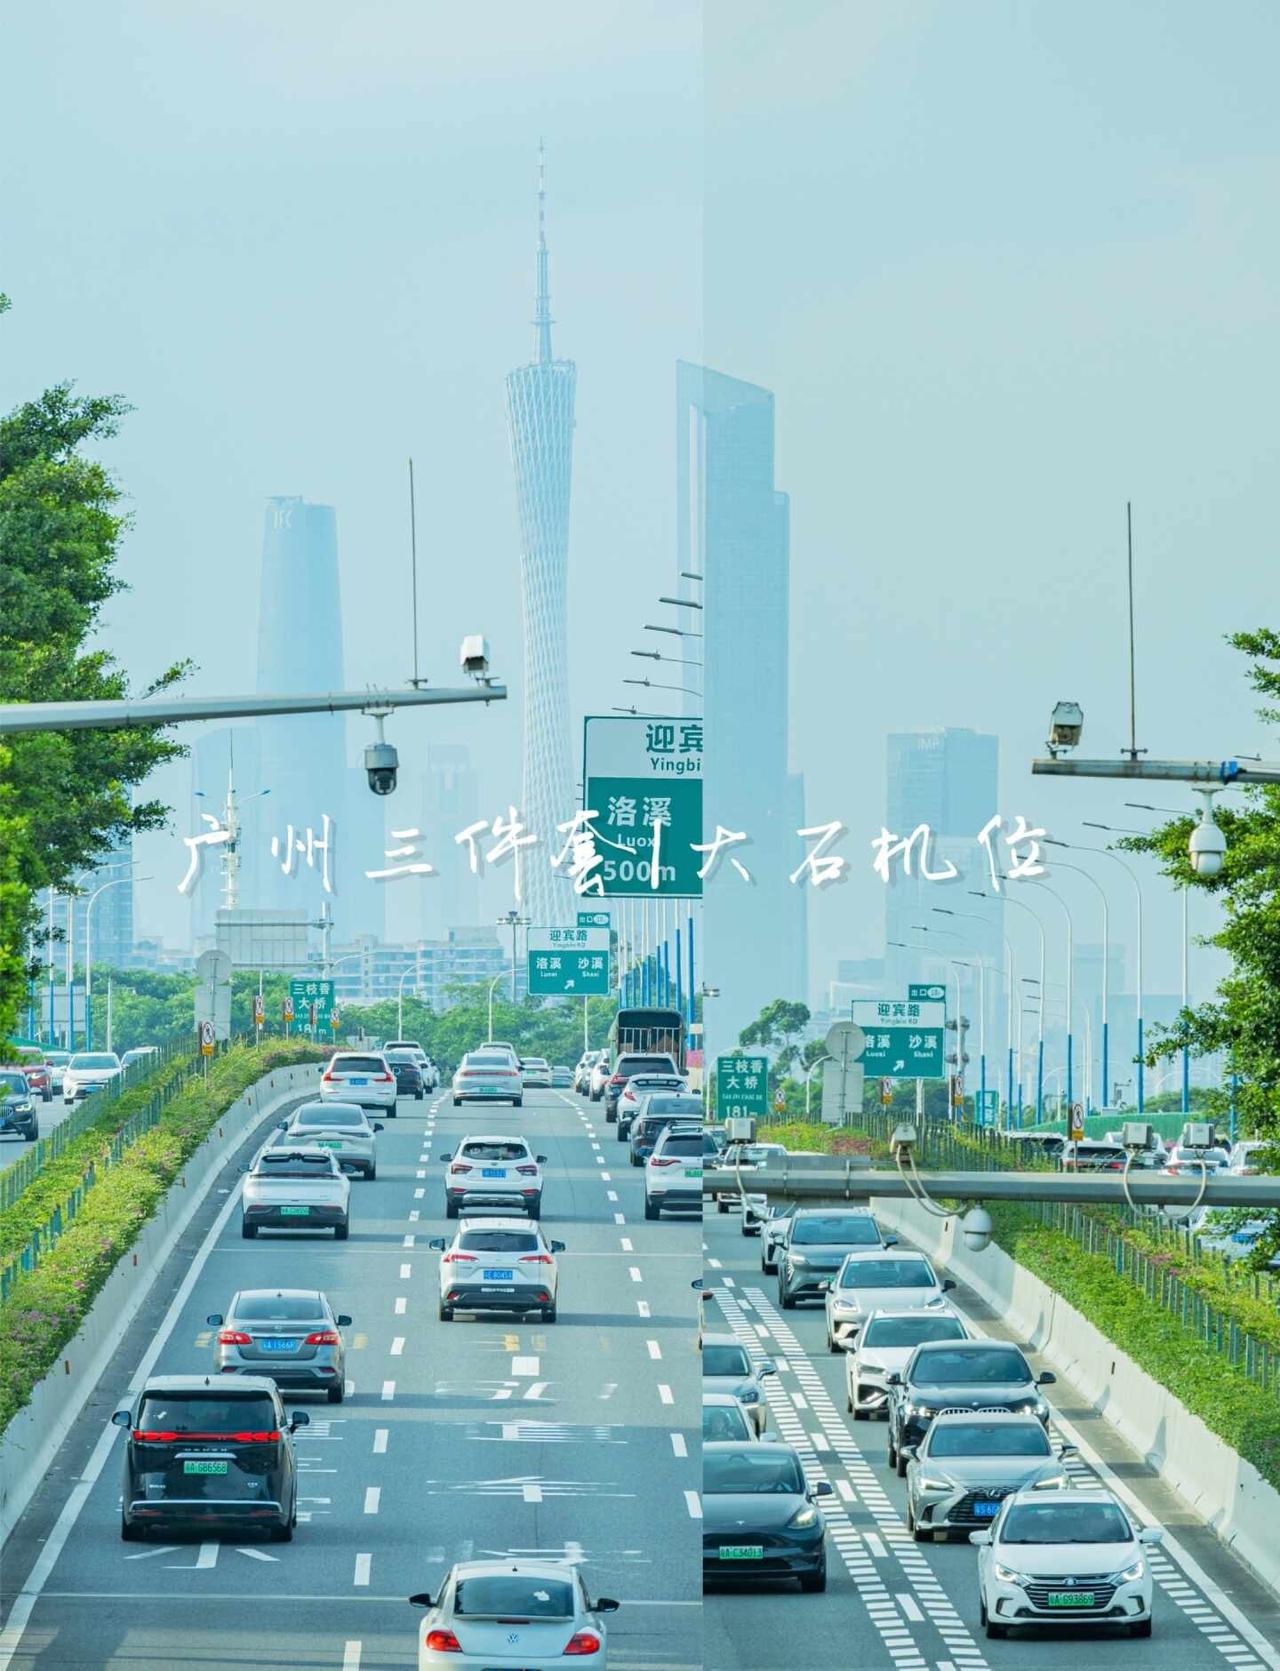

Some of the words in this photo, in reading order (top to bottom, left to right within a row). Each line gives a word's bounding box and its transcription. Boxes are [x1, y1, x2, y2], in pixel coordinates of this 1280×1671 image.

[650, 757, 701, 775] Yingbi
[607, 796, 671, 827] 洛溪
[617, 833, 658, 848] Luox
[603, 860, 676, 882] 500m
[550, 929, 588, 942] 迎宾路
[536, 957, 561, 969] 洛溪
[578, 957, 603, 969] 沙溪
[293, 982, 330, 996] 三枝香
[878, 1002, 920, 1017] 迎宾路
[908, 1034, 937, 1049] 沙溪
[721, 1059, 764, 1074] 三枝香
[726, 1075, 758, 1089] 大桥
